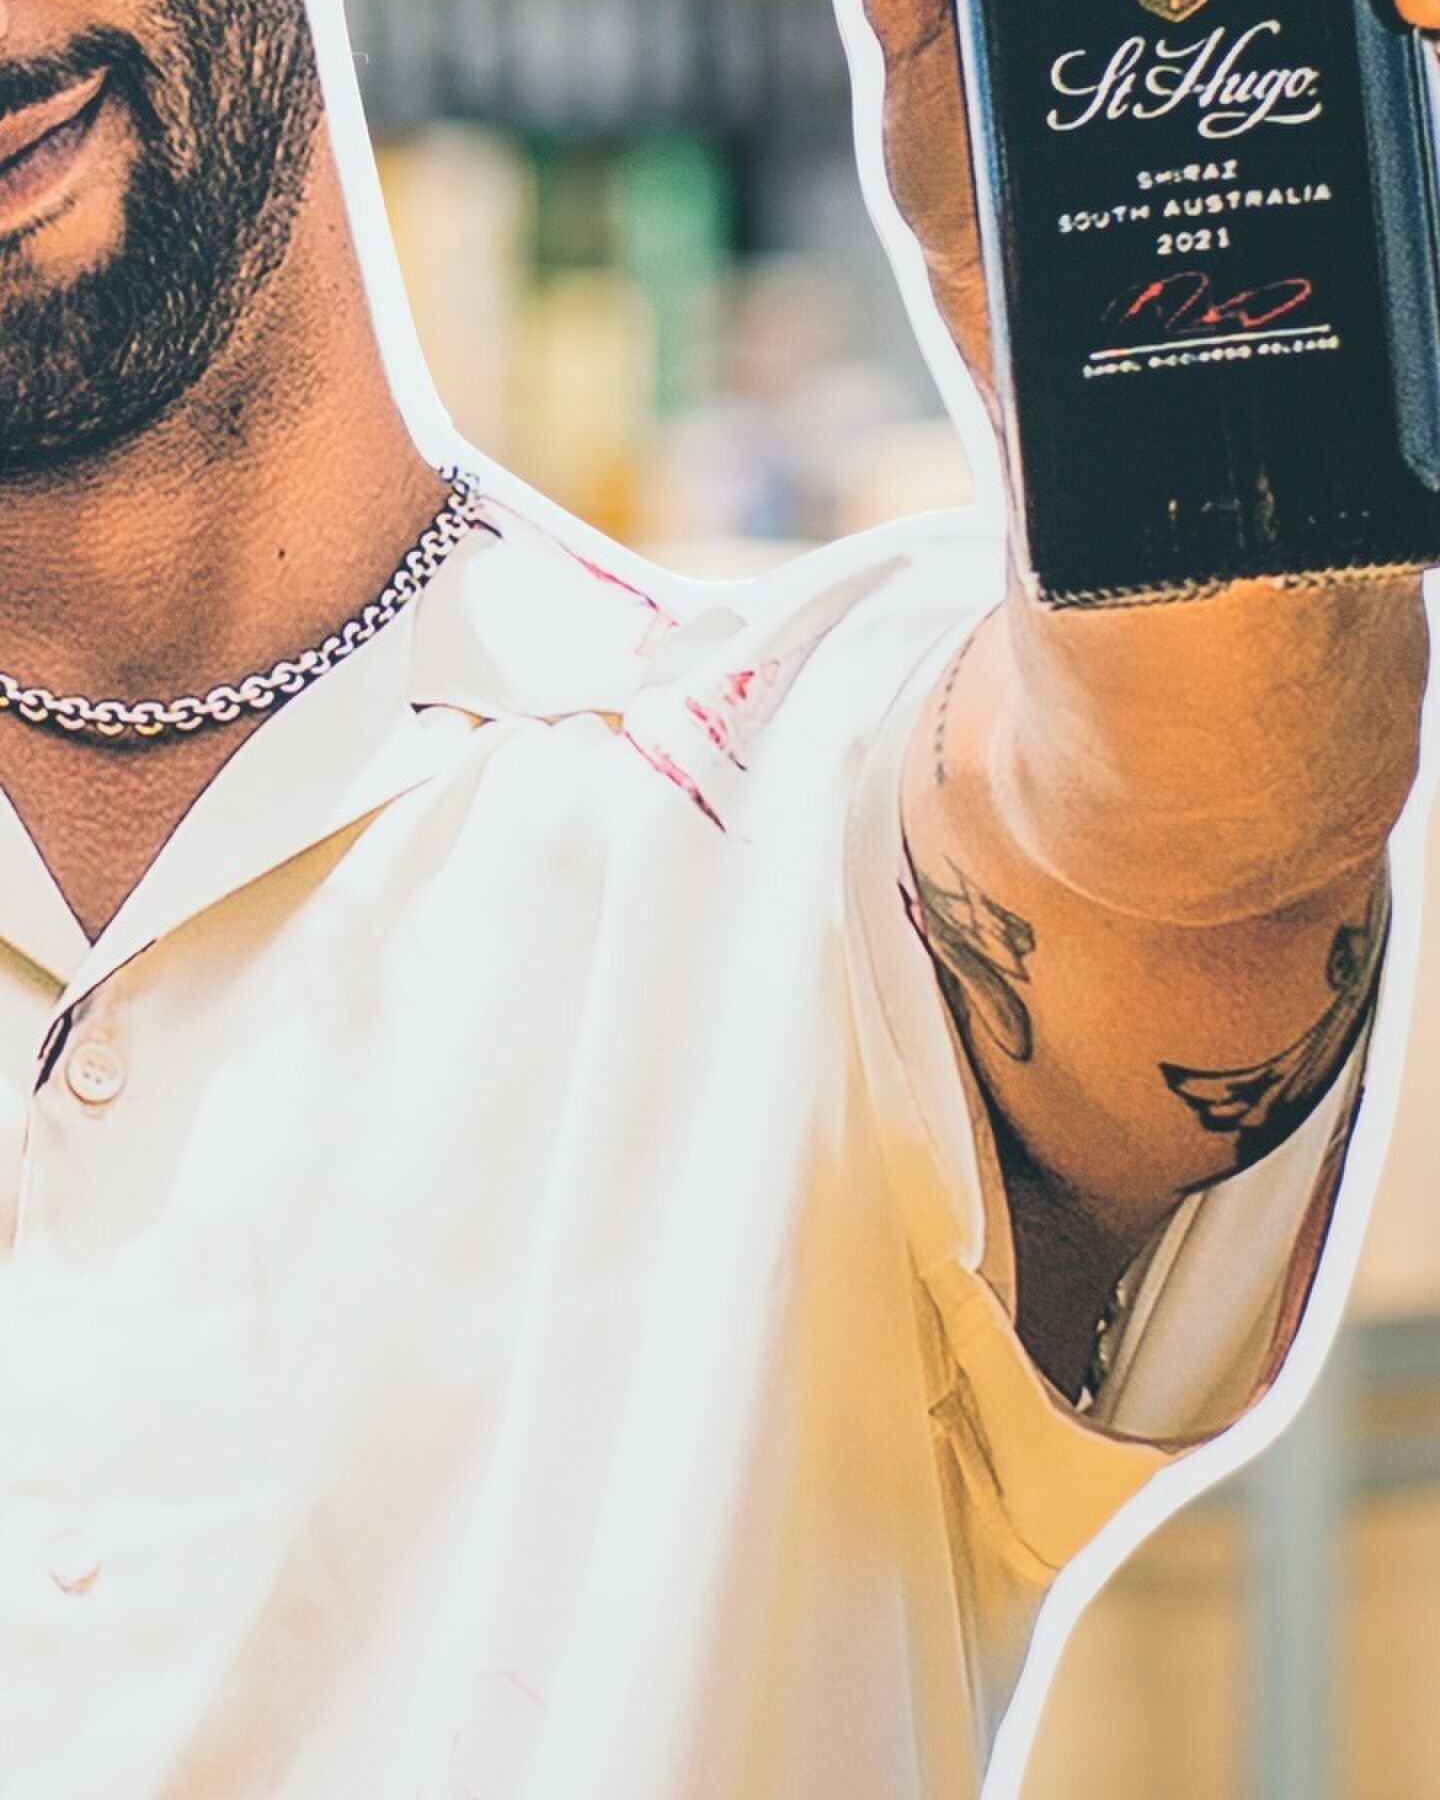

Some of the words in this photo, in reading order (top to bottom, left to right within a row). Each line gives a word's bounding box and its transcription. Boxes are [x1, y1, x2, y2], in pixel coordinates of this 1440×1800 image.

[1057, 204, 1151, 233] SOUTH
[1162, 183, 1333, 218] AUSTRALIA
[1156, 226, 1231, 256] 2021
